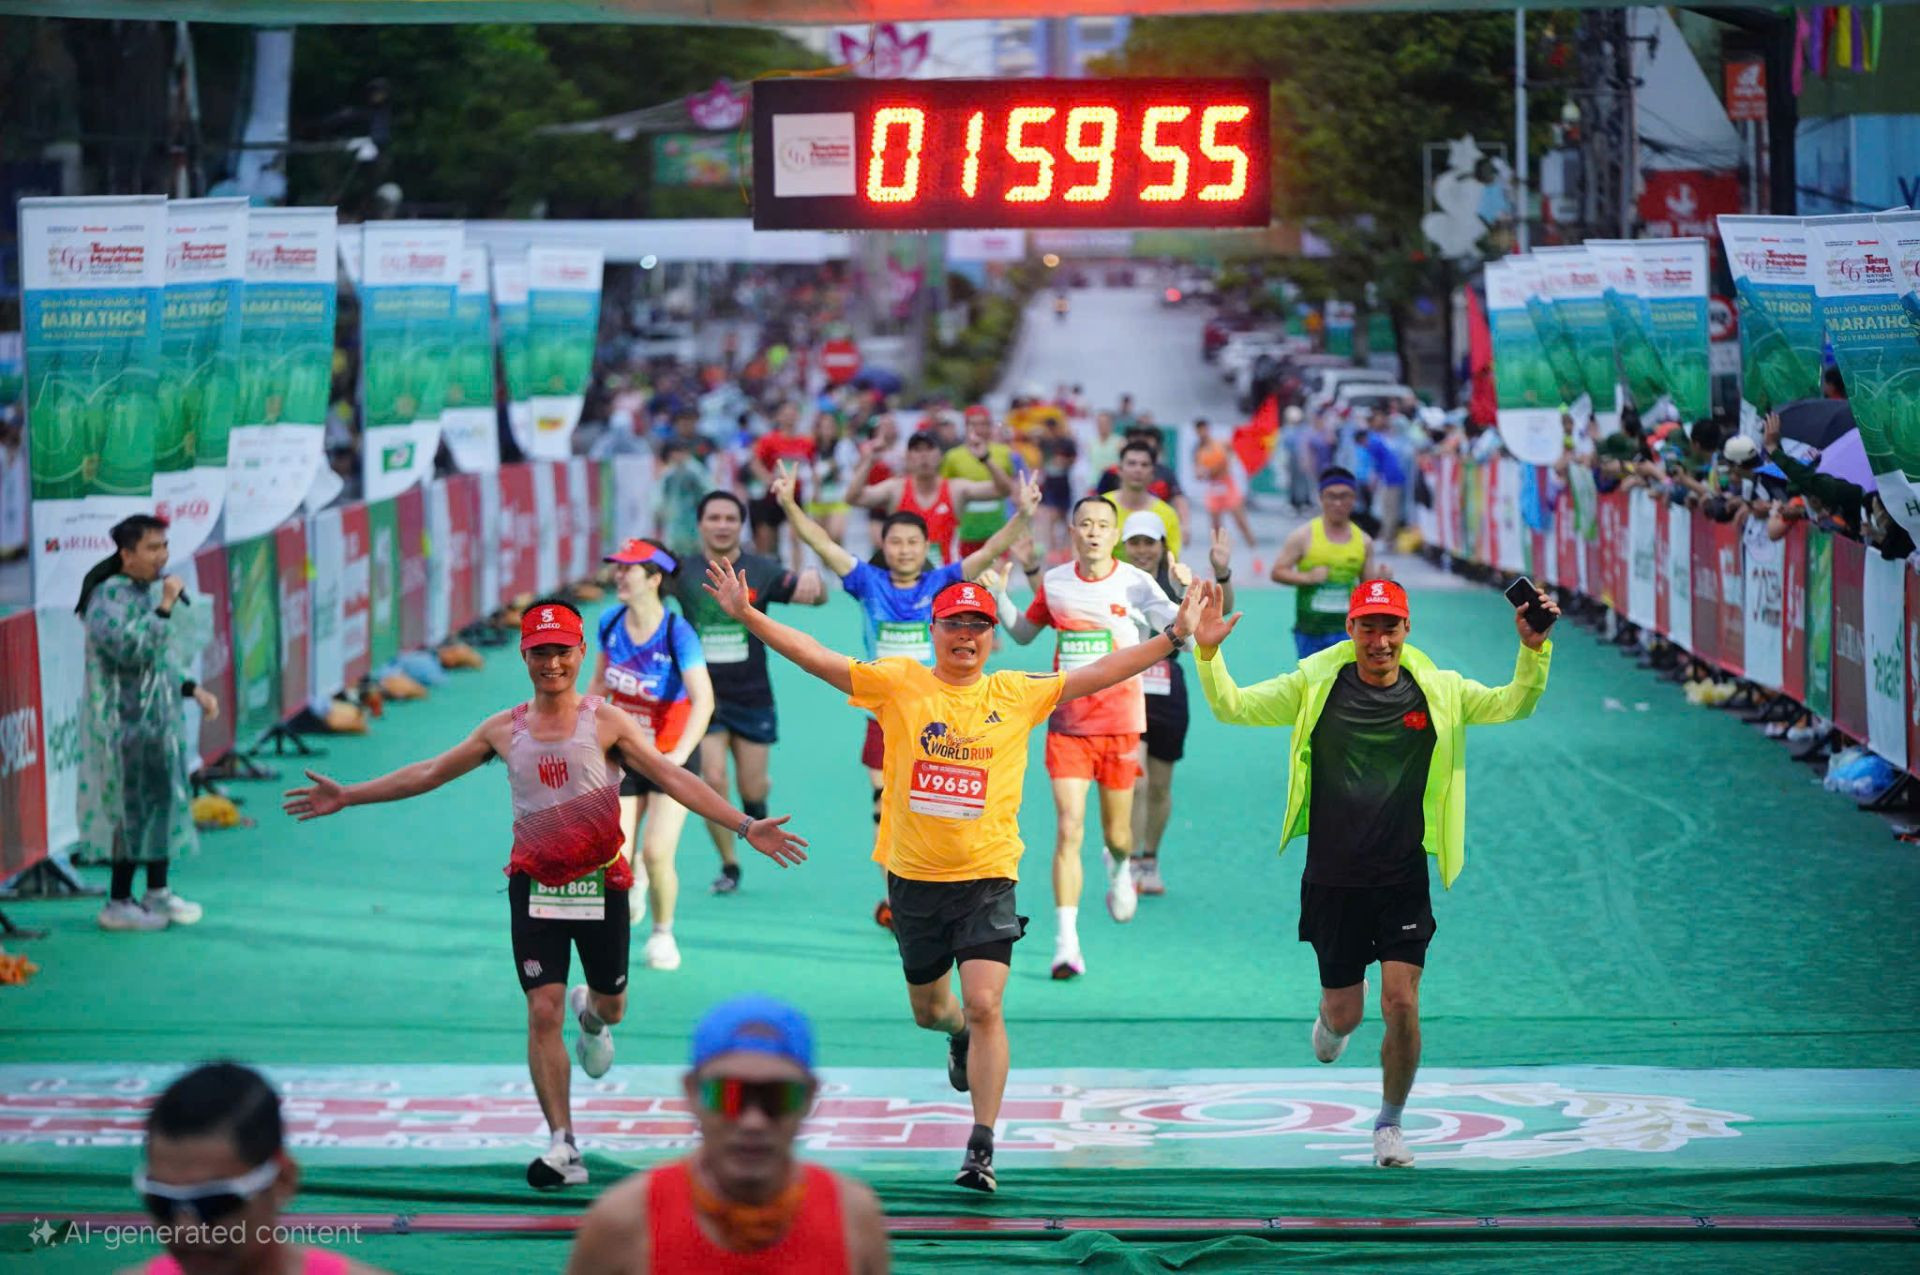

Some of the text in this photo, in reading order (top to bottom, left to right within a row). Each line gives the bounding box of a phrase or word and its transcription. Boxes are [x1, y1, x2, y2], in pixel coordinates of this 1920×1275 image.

[866, 105, 1251, 203] 01 59 55
[931, 741, 993, 760] WORLD RUN
[918, 773, 983, 796] V9659
